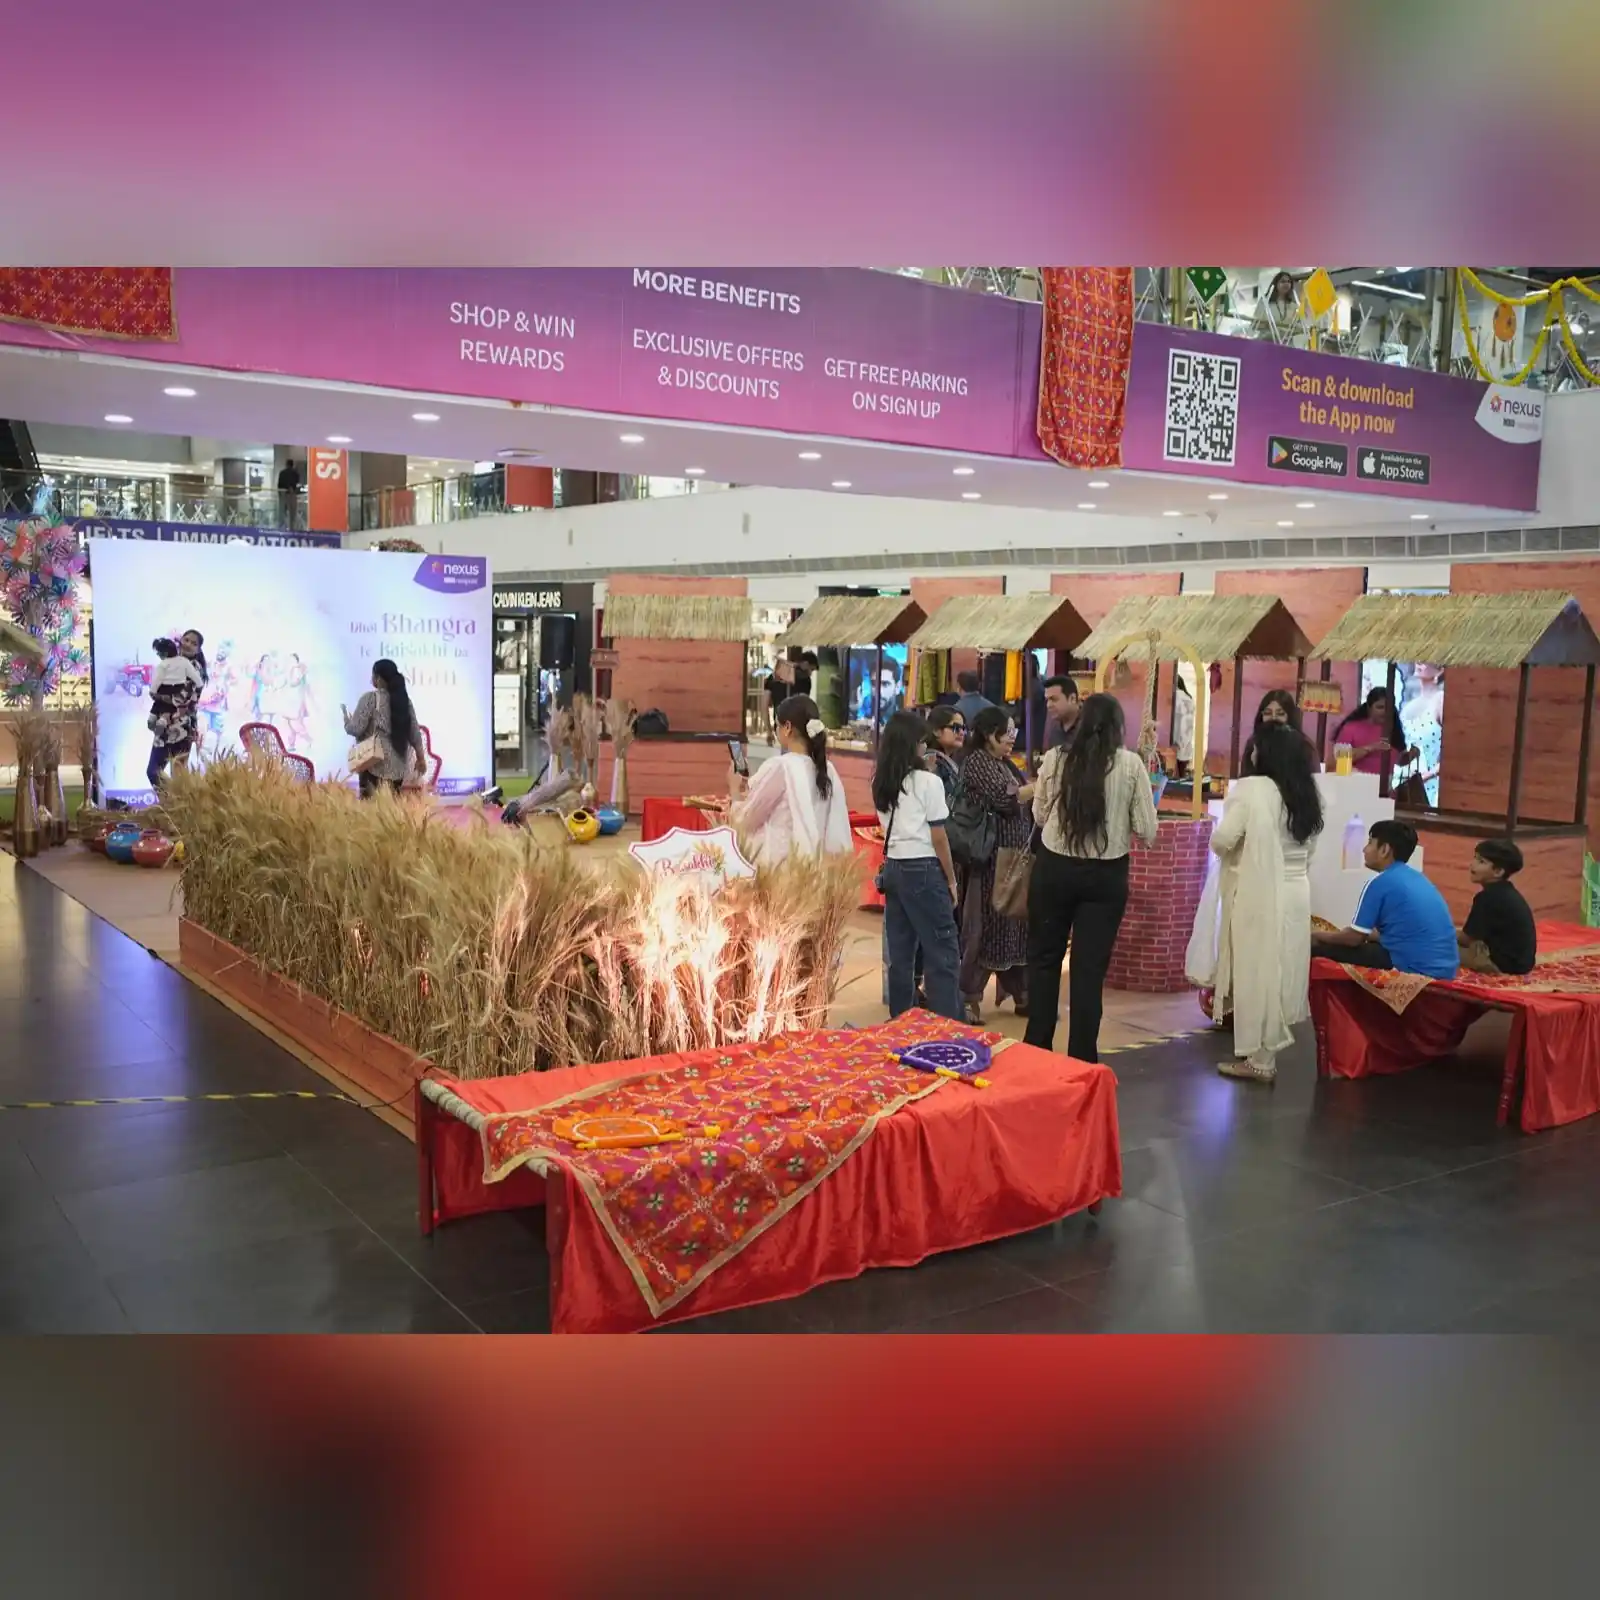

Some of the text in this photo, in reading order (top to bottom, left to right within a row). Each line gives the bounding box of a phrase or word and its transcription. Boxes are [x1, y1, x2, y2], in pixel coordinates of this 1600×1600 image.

[633, 268, 801, 314] MORE BENEFITS
[450, 302, 575, 338] SHOP & WIN
[460, 339, 565, 372] REWARDS
[633, 328, 804, 372] EXCLUSIVE OFFERS
[657, 366, 780, 400] & DISCOUNTS
[824, 358, 968, 396] GET FREE PARKING
[1281, 368, 1415, 409] Scan & download
[853, 391, 941, 420] ON SIGN UP
[1300, 401, 1396, 435] the App now
[1504, 400, 1541, 418] nexus
[1292, 452, 1343, 473] Google Play
[1380, 463, 1424, 480] App Store
[443, 563, 480, 576] nexus
[493, 591, 562, 608] CALVIN KLEIN JEANS
[382, 612, 476, 642] Bhangra
